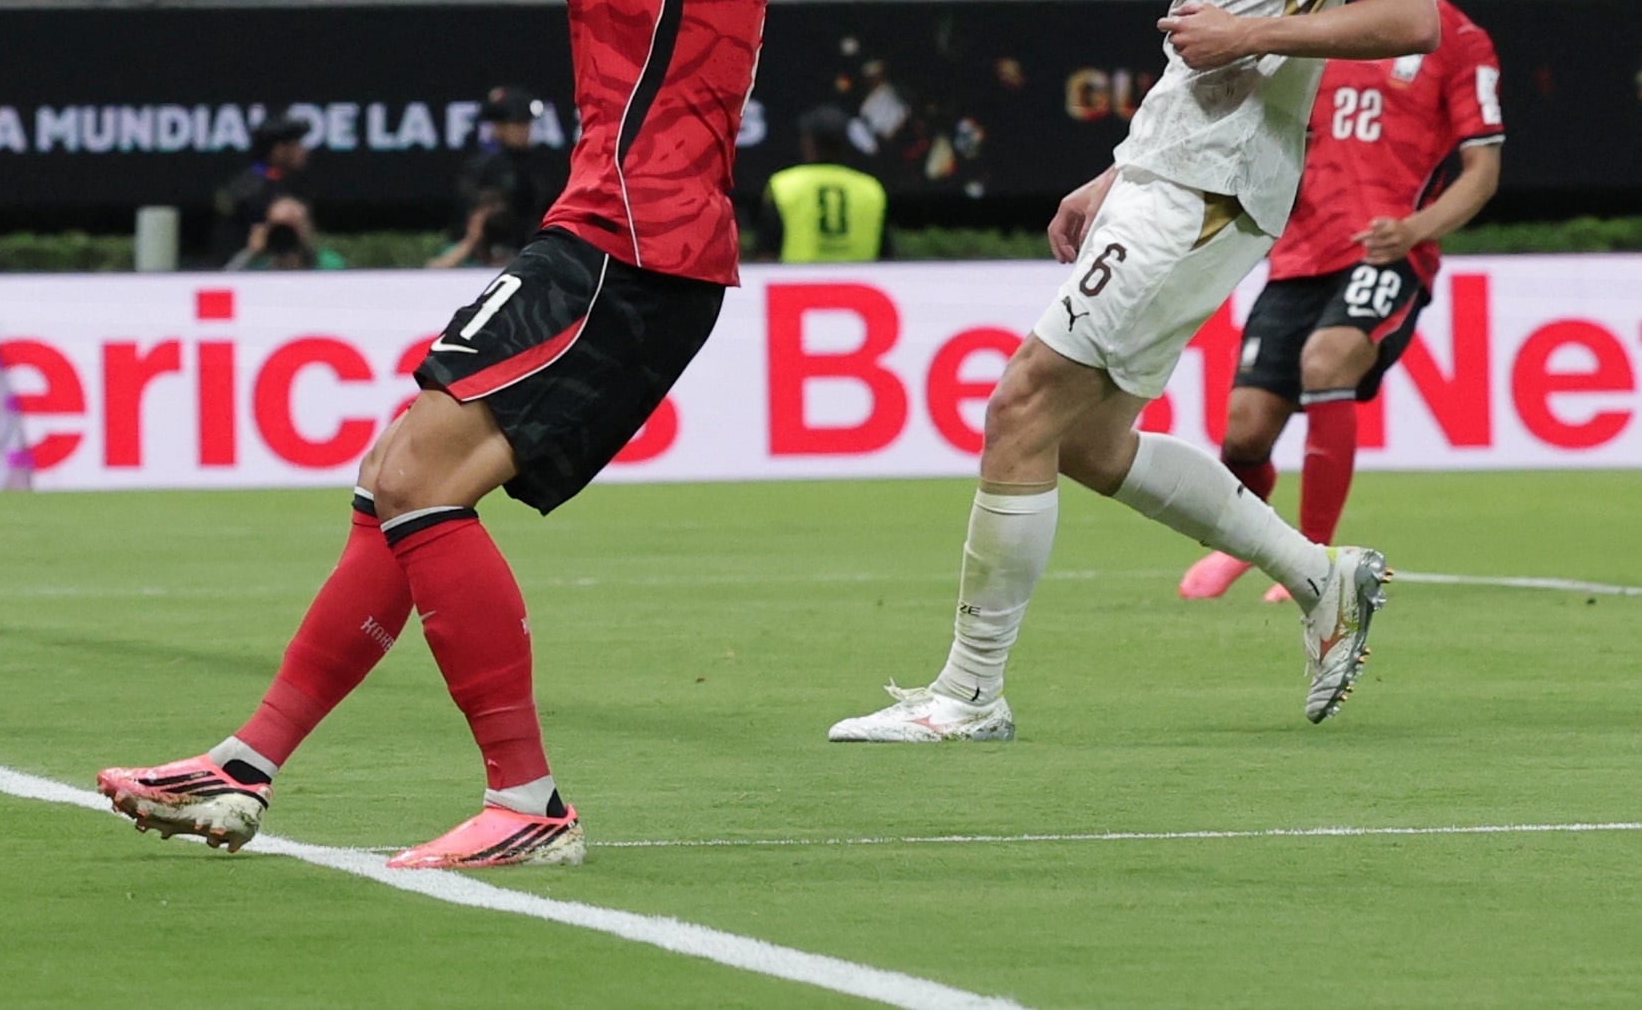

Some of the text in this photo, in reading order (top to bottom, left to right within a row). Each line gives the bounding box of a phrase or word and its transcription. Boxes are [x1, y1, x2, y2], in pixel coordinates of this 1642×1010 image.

[365, 100, 438, 150] LA
[1332, 86, 1383, 142] 22
[1079, 242, 1127, 297] 6
[1344, 265, 1402, 318] 22
[460, 273, 522, 340] 7
[766, 282, 1240, 460] Bet
